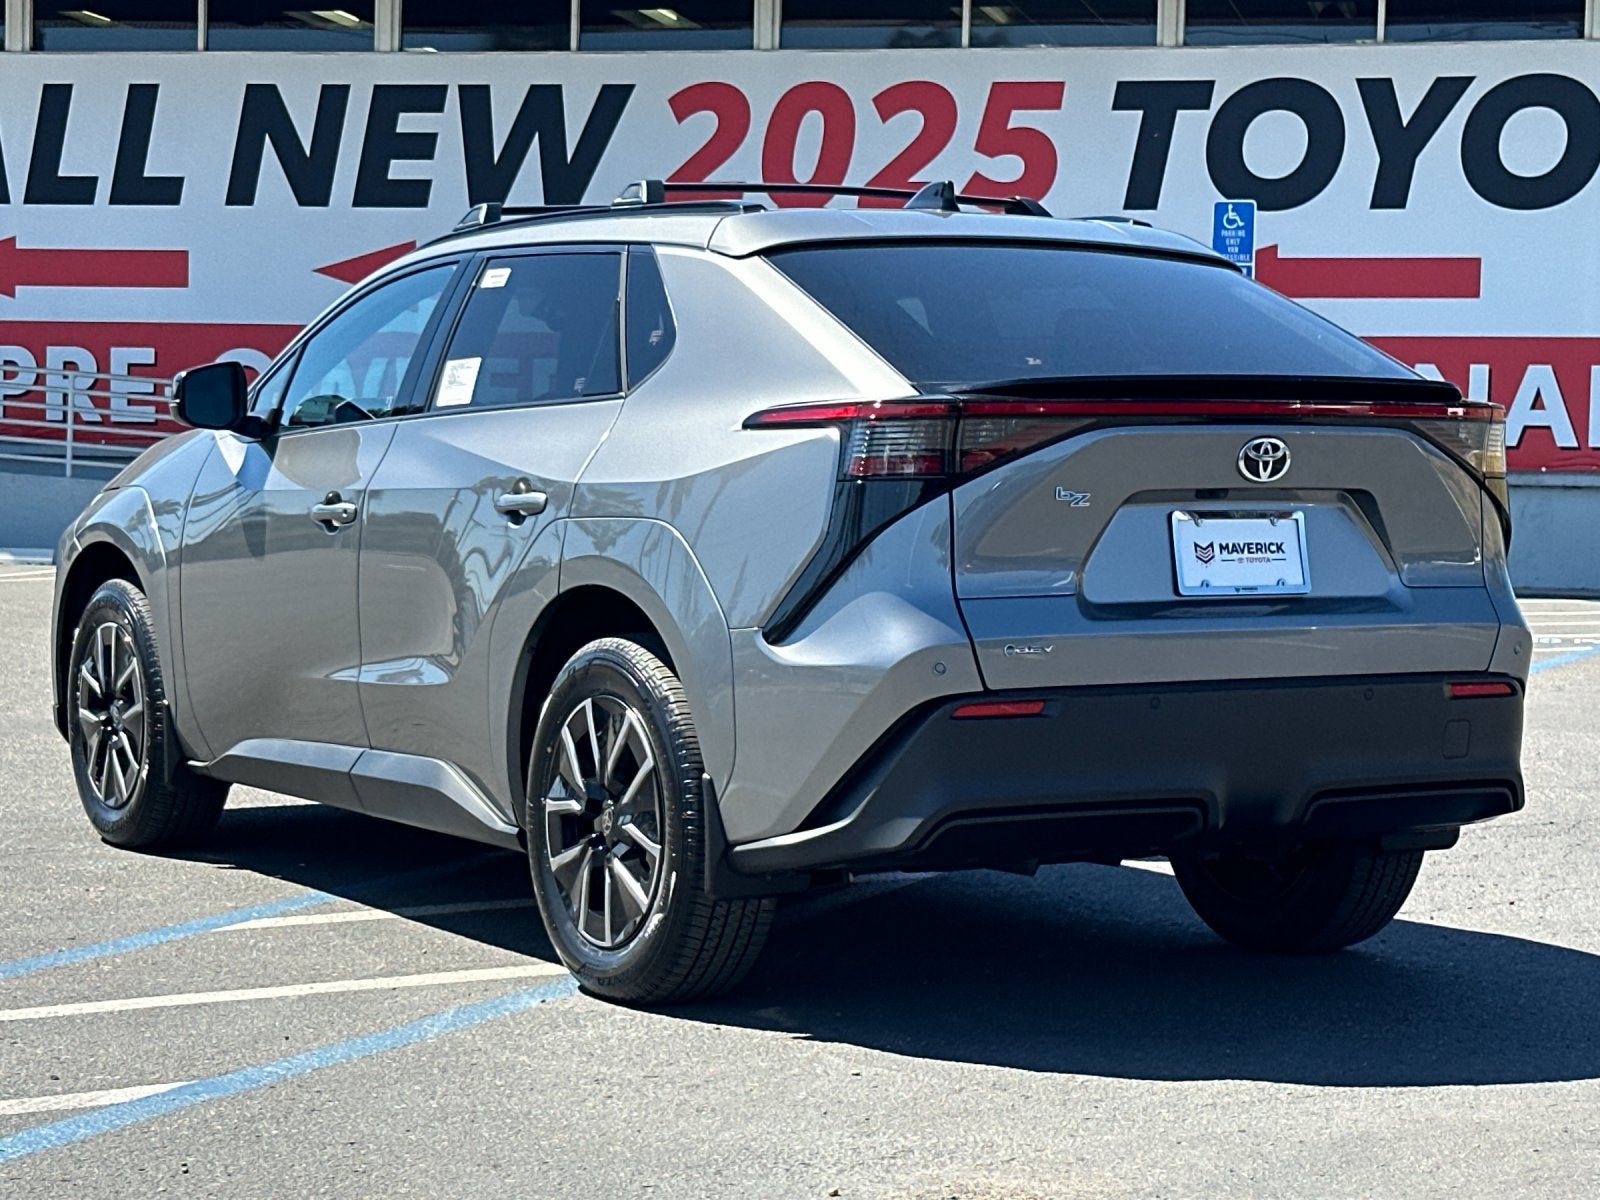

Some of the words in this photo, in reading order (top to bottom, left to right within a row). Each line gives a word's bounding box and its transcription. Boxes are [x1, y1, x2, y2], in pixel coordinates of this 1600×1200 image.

[0, 83, 184, 206] LL
[225, 83, 636, 208] NEW
[664, 80, 1066, 209] 2025
[1221, 229, 1245, 237] PARKING
[1218, 541, 1285, 555] MAVERICK
[1245, 556, 1271, 564] TOYOTA
